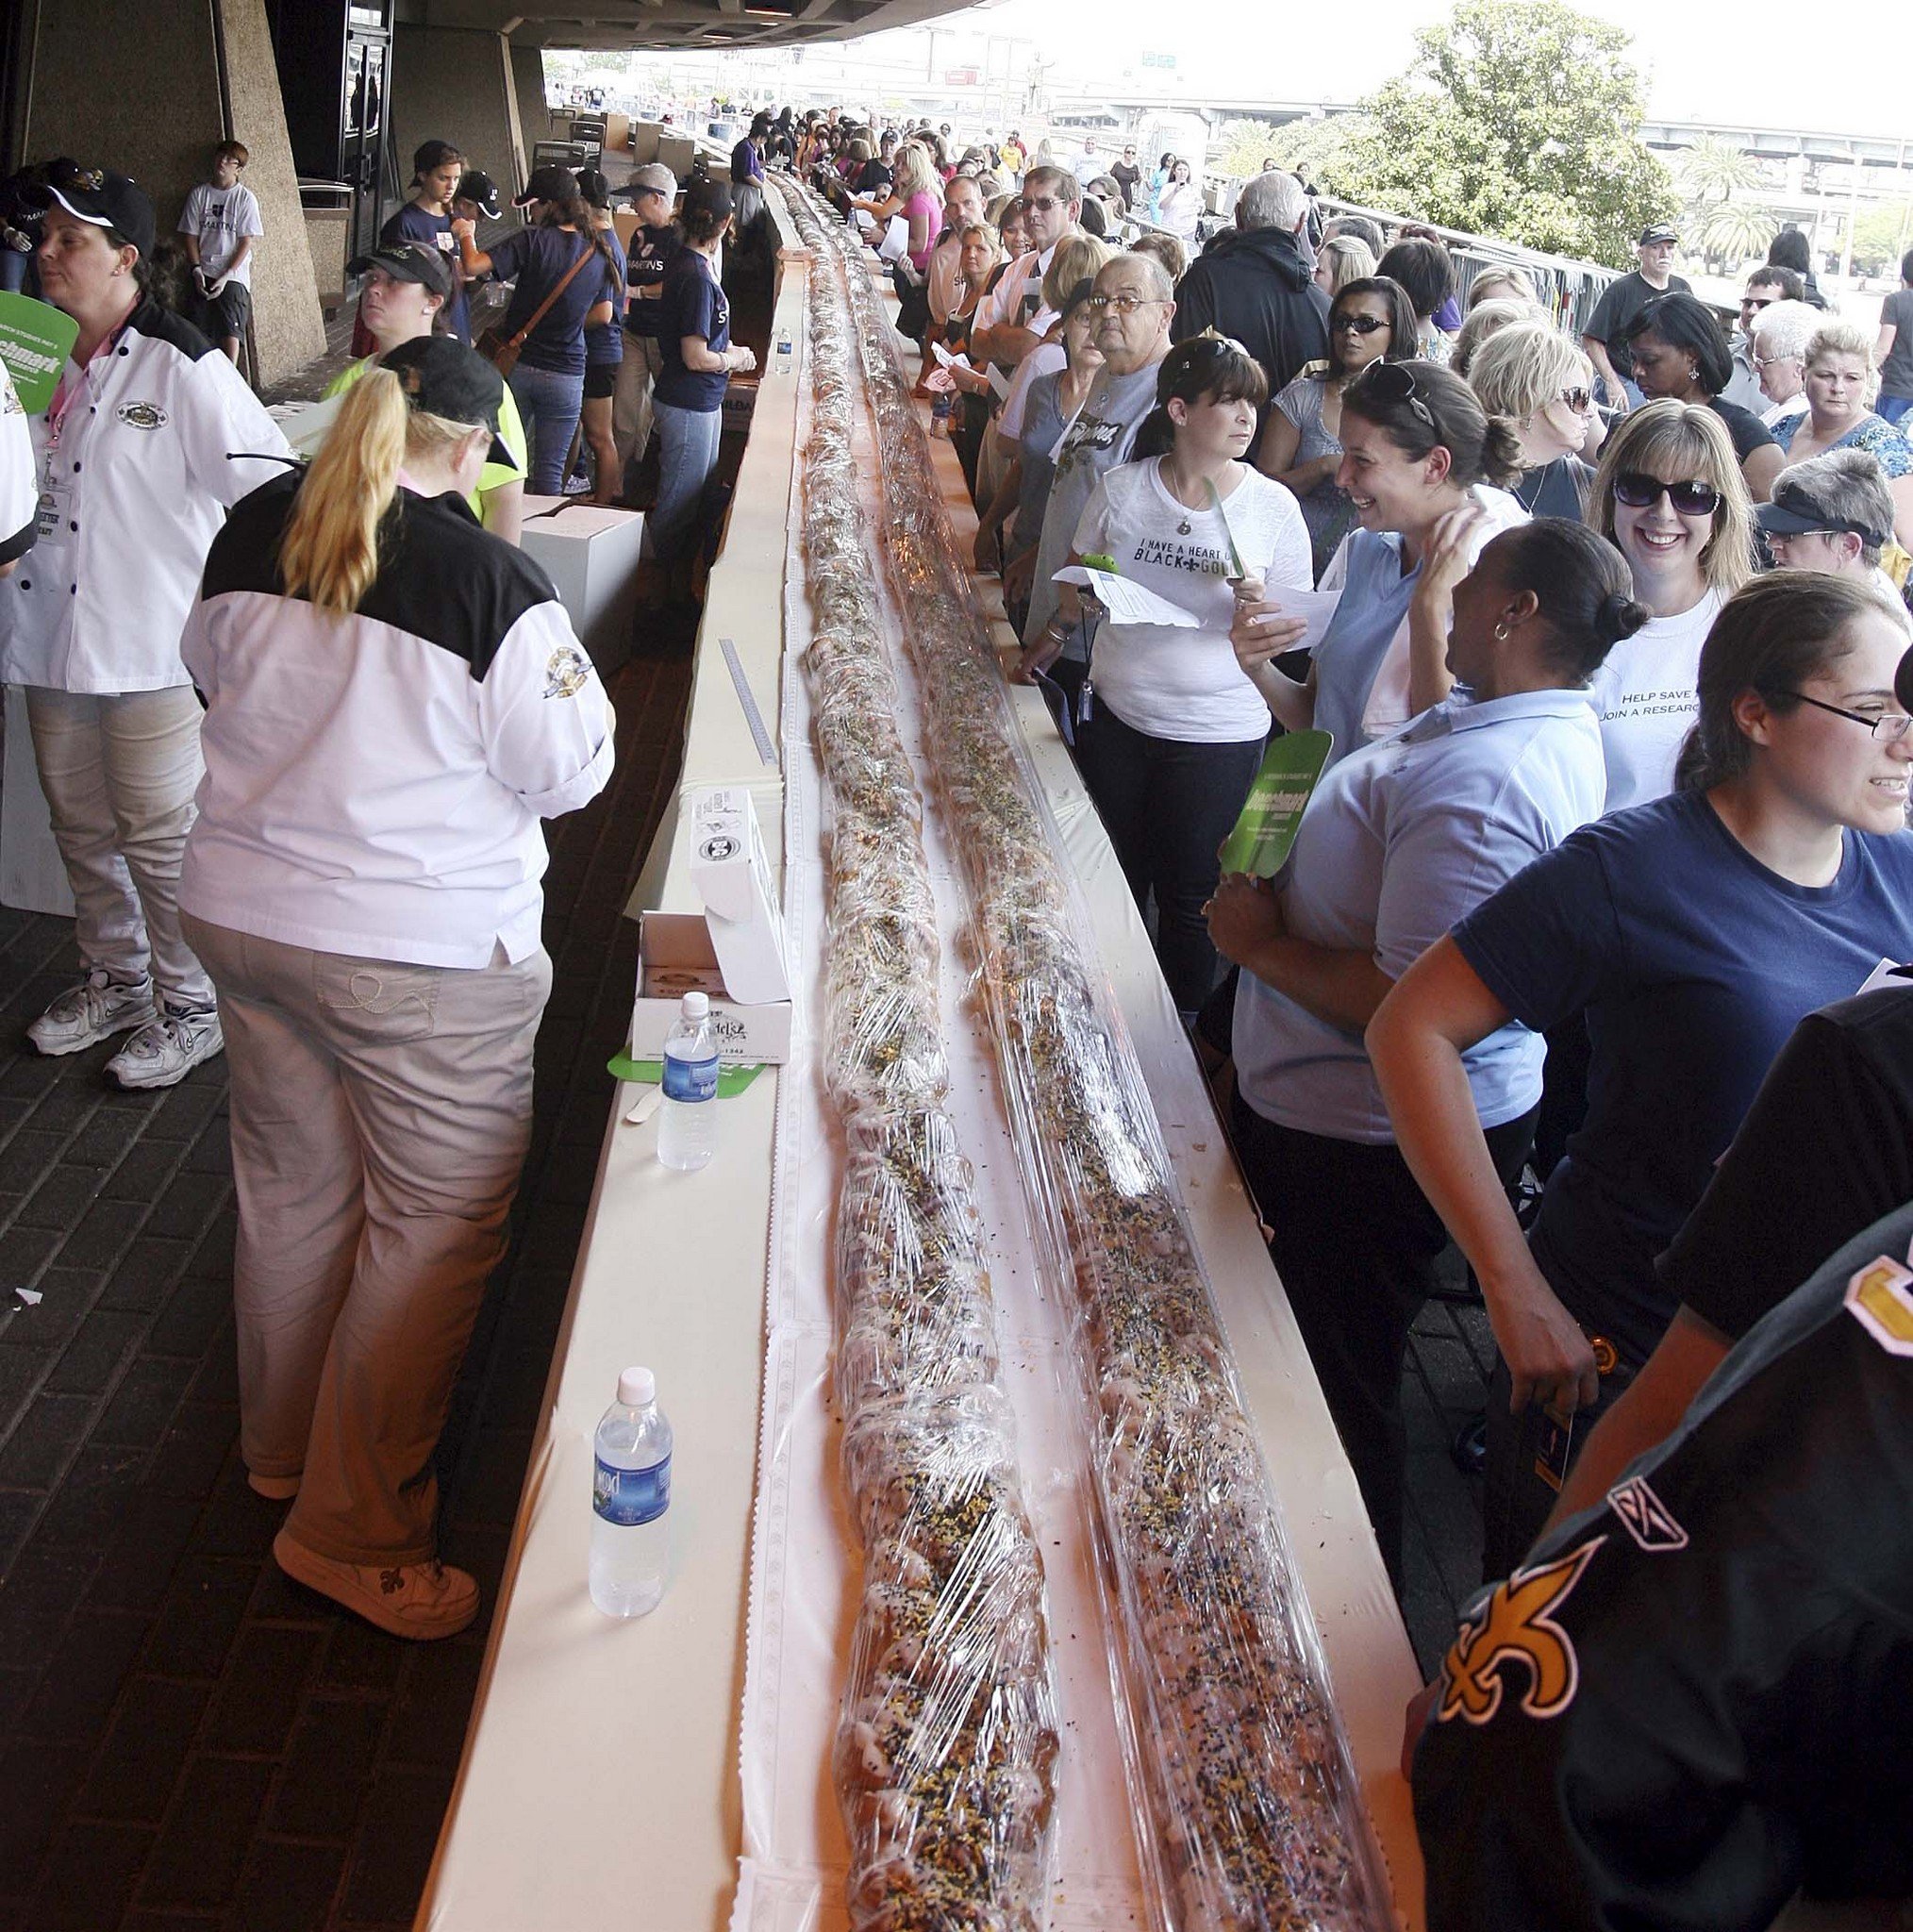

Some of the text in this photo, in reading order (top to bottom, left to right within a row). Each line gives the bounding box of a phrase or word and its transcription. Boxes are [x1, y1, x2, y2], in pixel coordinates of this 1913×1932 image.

[1140, 538, 1145, 547] I
[1148, 540, 1173, 553] HAVE
[1177, 545, 1184, 554] A
[1189, 546, 1221, 560] HEART
[1134, 548, 1230, 576] BLACK GOL
[1622, 690, 1692, 704] HELP SAVE
[1599, 709, 1628, 722] JOIN
[1631, 708, 1639, 717] A
